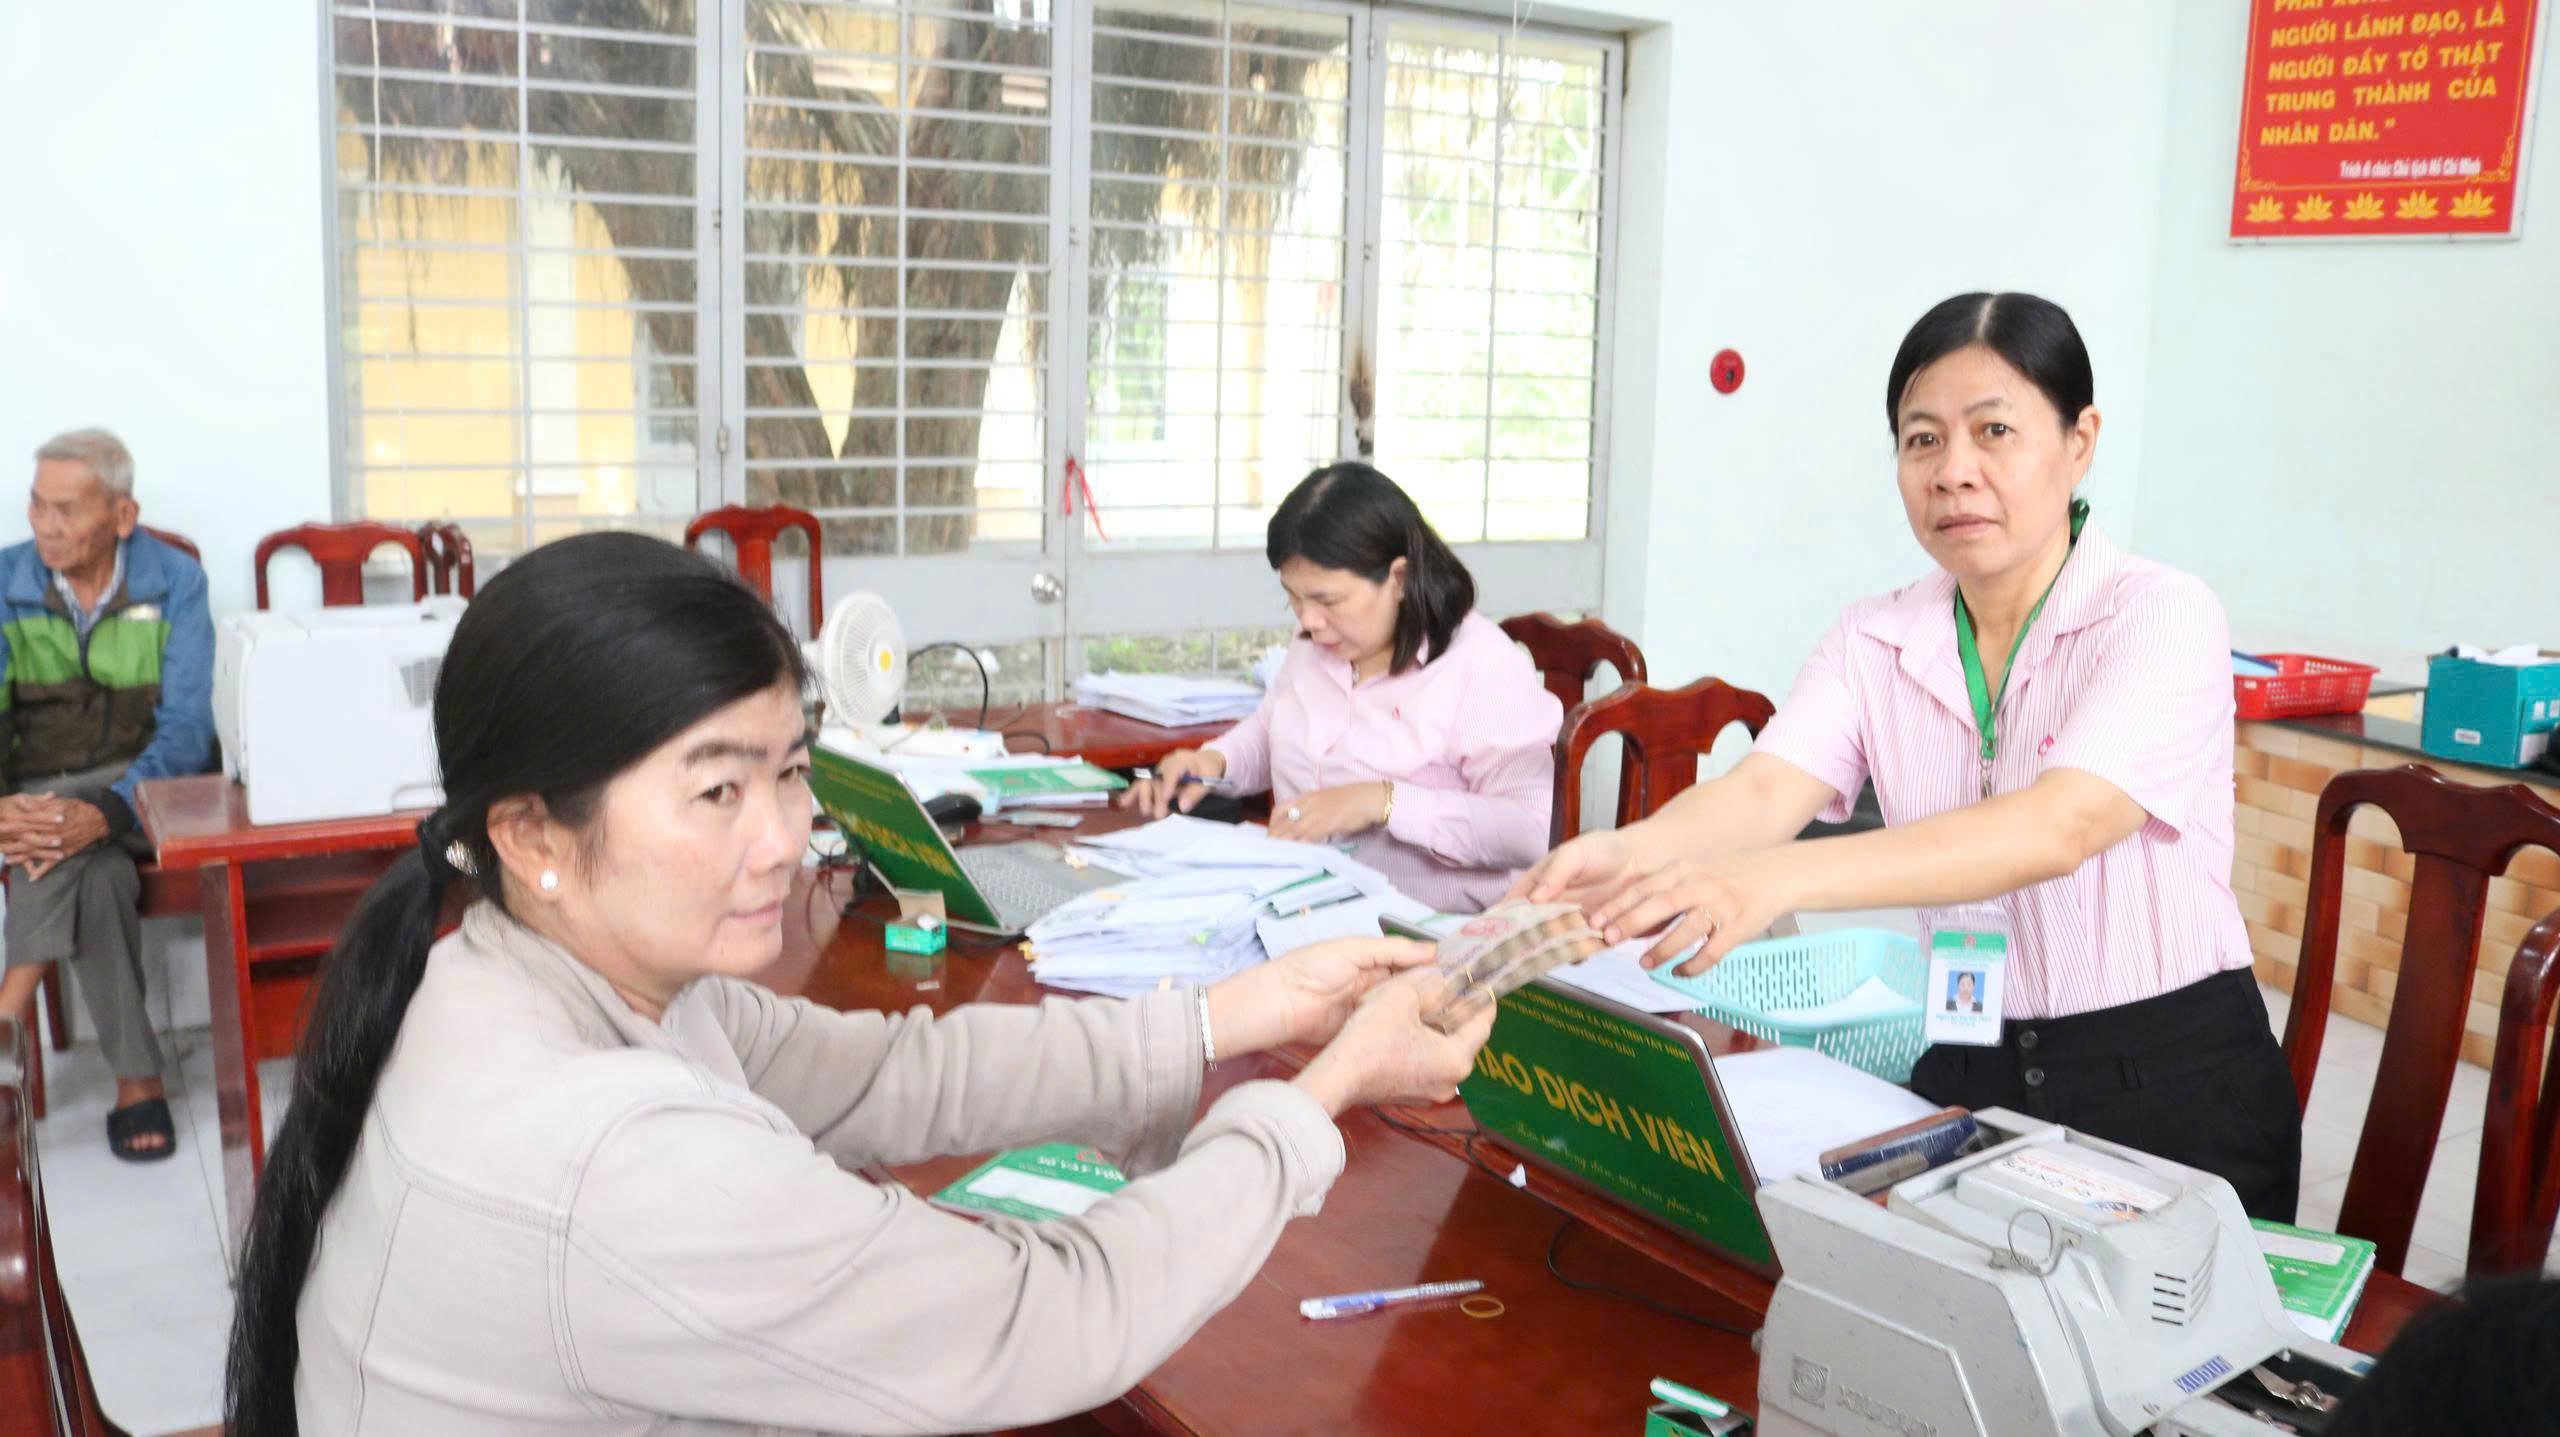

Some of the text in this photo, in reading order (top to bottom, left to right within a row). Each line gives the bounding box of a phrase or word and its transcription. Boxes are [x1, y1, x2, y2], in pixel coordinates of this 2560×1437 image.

[2410, 9, 2466, 38] ĐẠO,
[2265, 69, 2496, 113] TRUNG THÀNH CỦA
[2260, 120, 2319, 145] NHÂN
[1475, 1045, 1534, 1096] IAO
